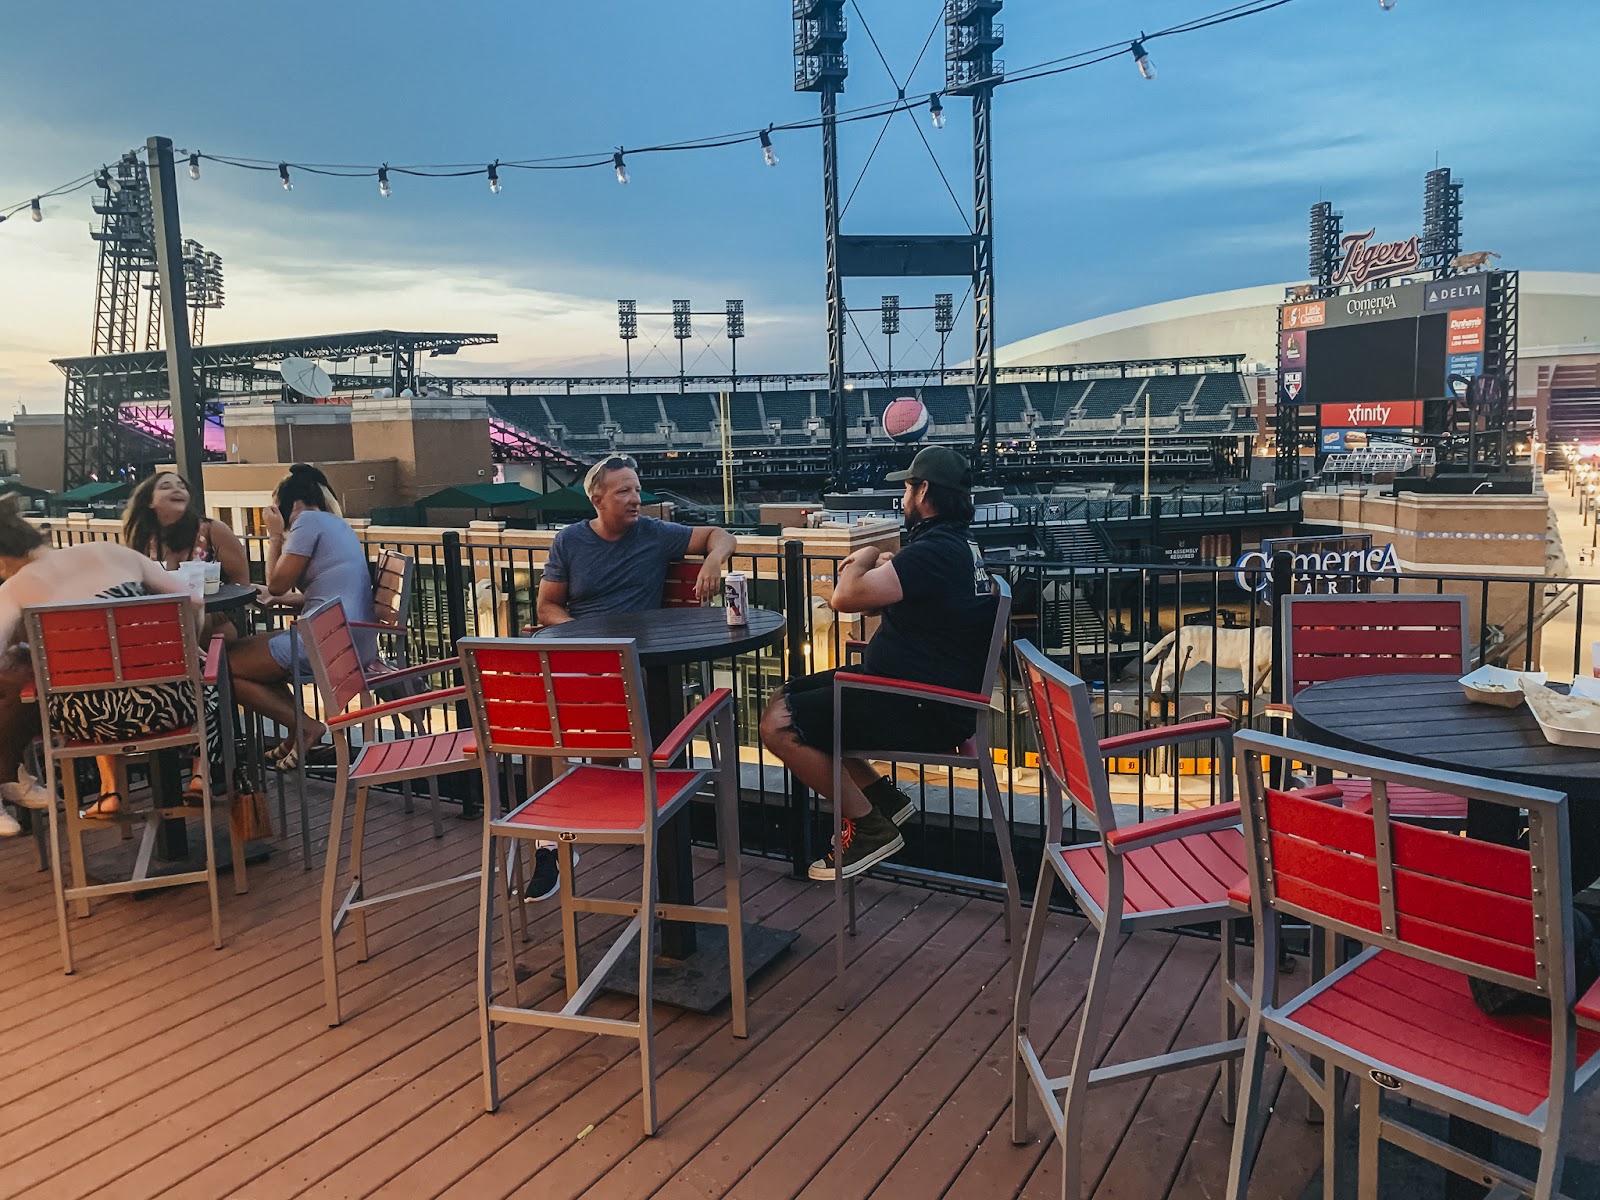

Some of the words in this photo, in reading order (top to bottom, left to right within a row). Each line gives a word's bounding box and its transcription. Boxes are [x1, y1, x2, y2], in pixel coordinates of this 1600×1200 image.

[1331, 227, 1420, 291] Tigers
[1441, 284, 1481, 300] DELTA
[1304, 304, 1321, 316] Little
[1359, 308, 1383, 318] PARK
[1284, 372, 1302, 382] MLB
[1347, 403, 1391, 426] xfinity
